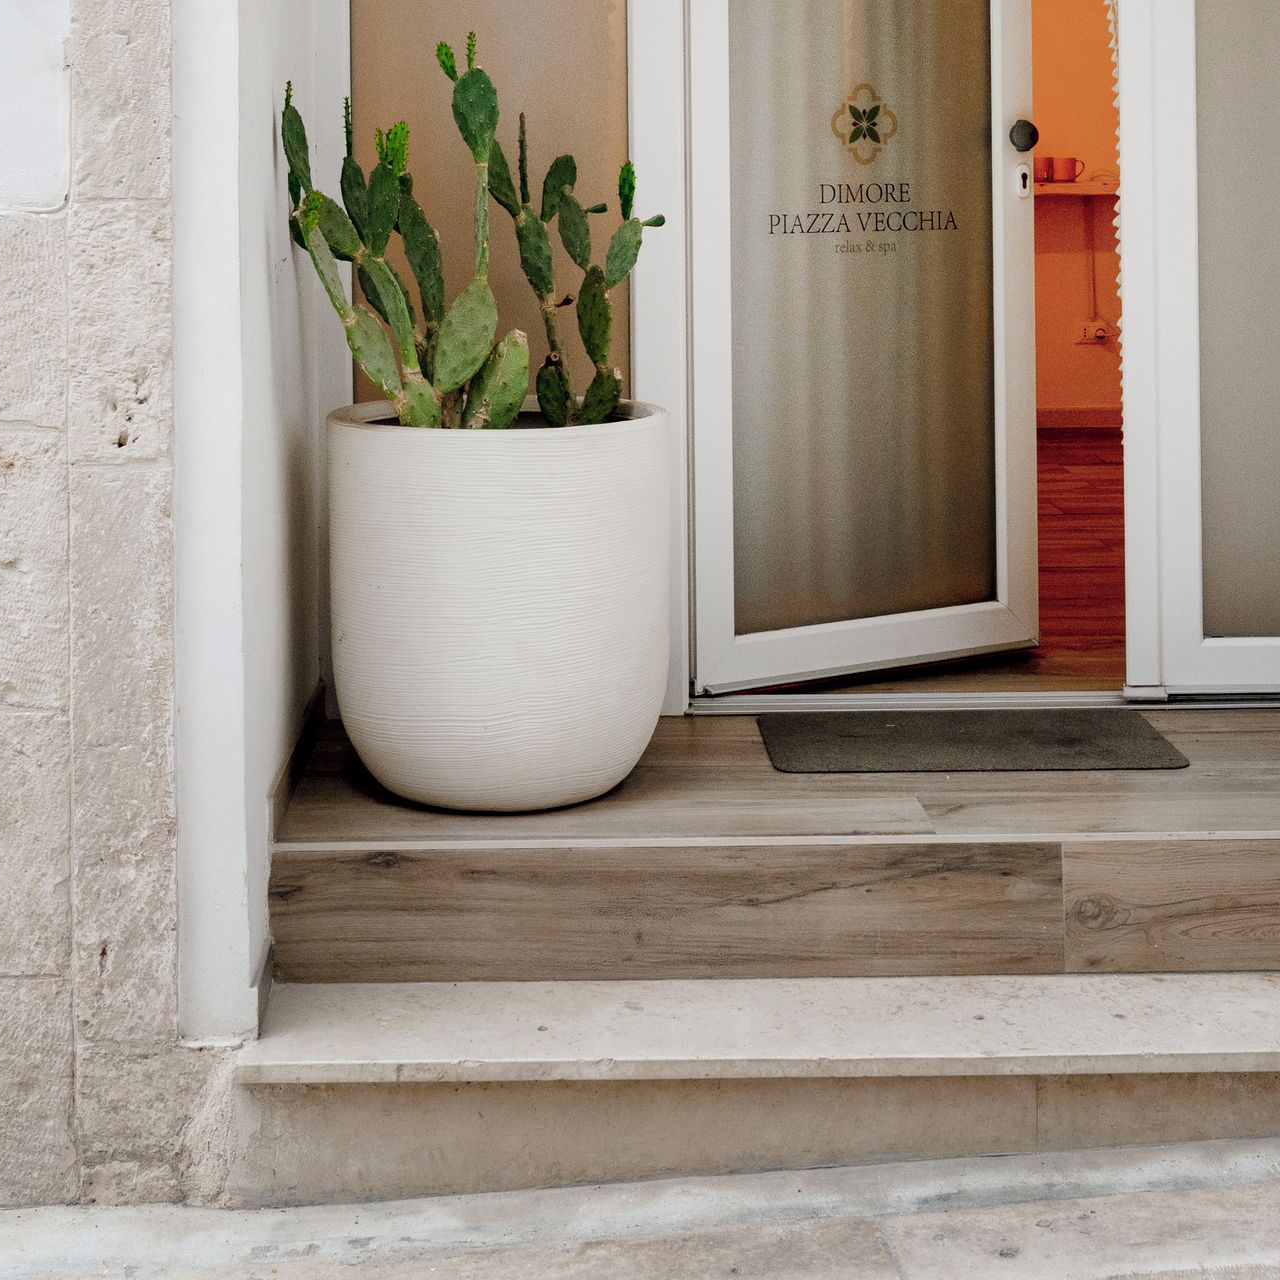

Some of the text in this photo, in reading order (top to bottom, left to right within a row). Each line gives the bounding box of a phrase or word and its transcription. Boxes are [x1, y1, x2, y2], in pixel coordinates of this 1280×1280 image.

[819, 182, 911, 204] DIMORE
[768, 211, 959, 234] PIAZZA VECCHIA
[835, 240, 897, 256] relax & spa
